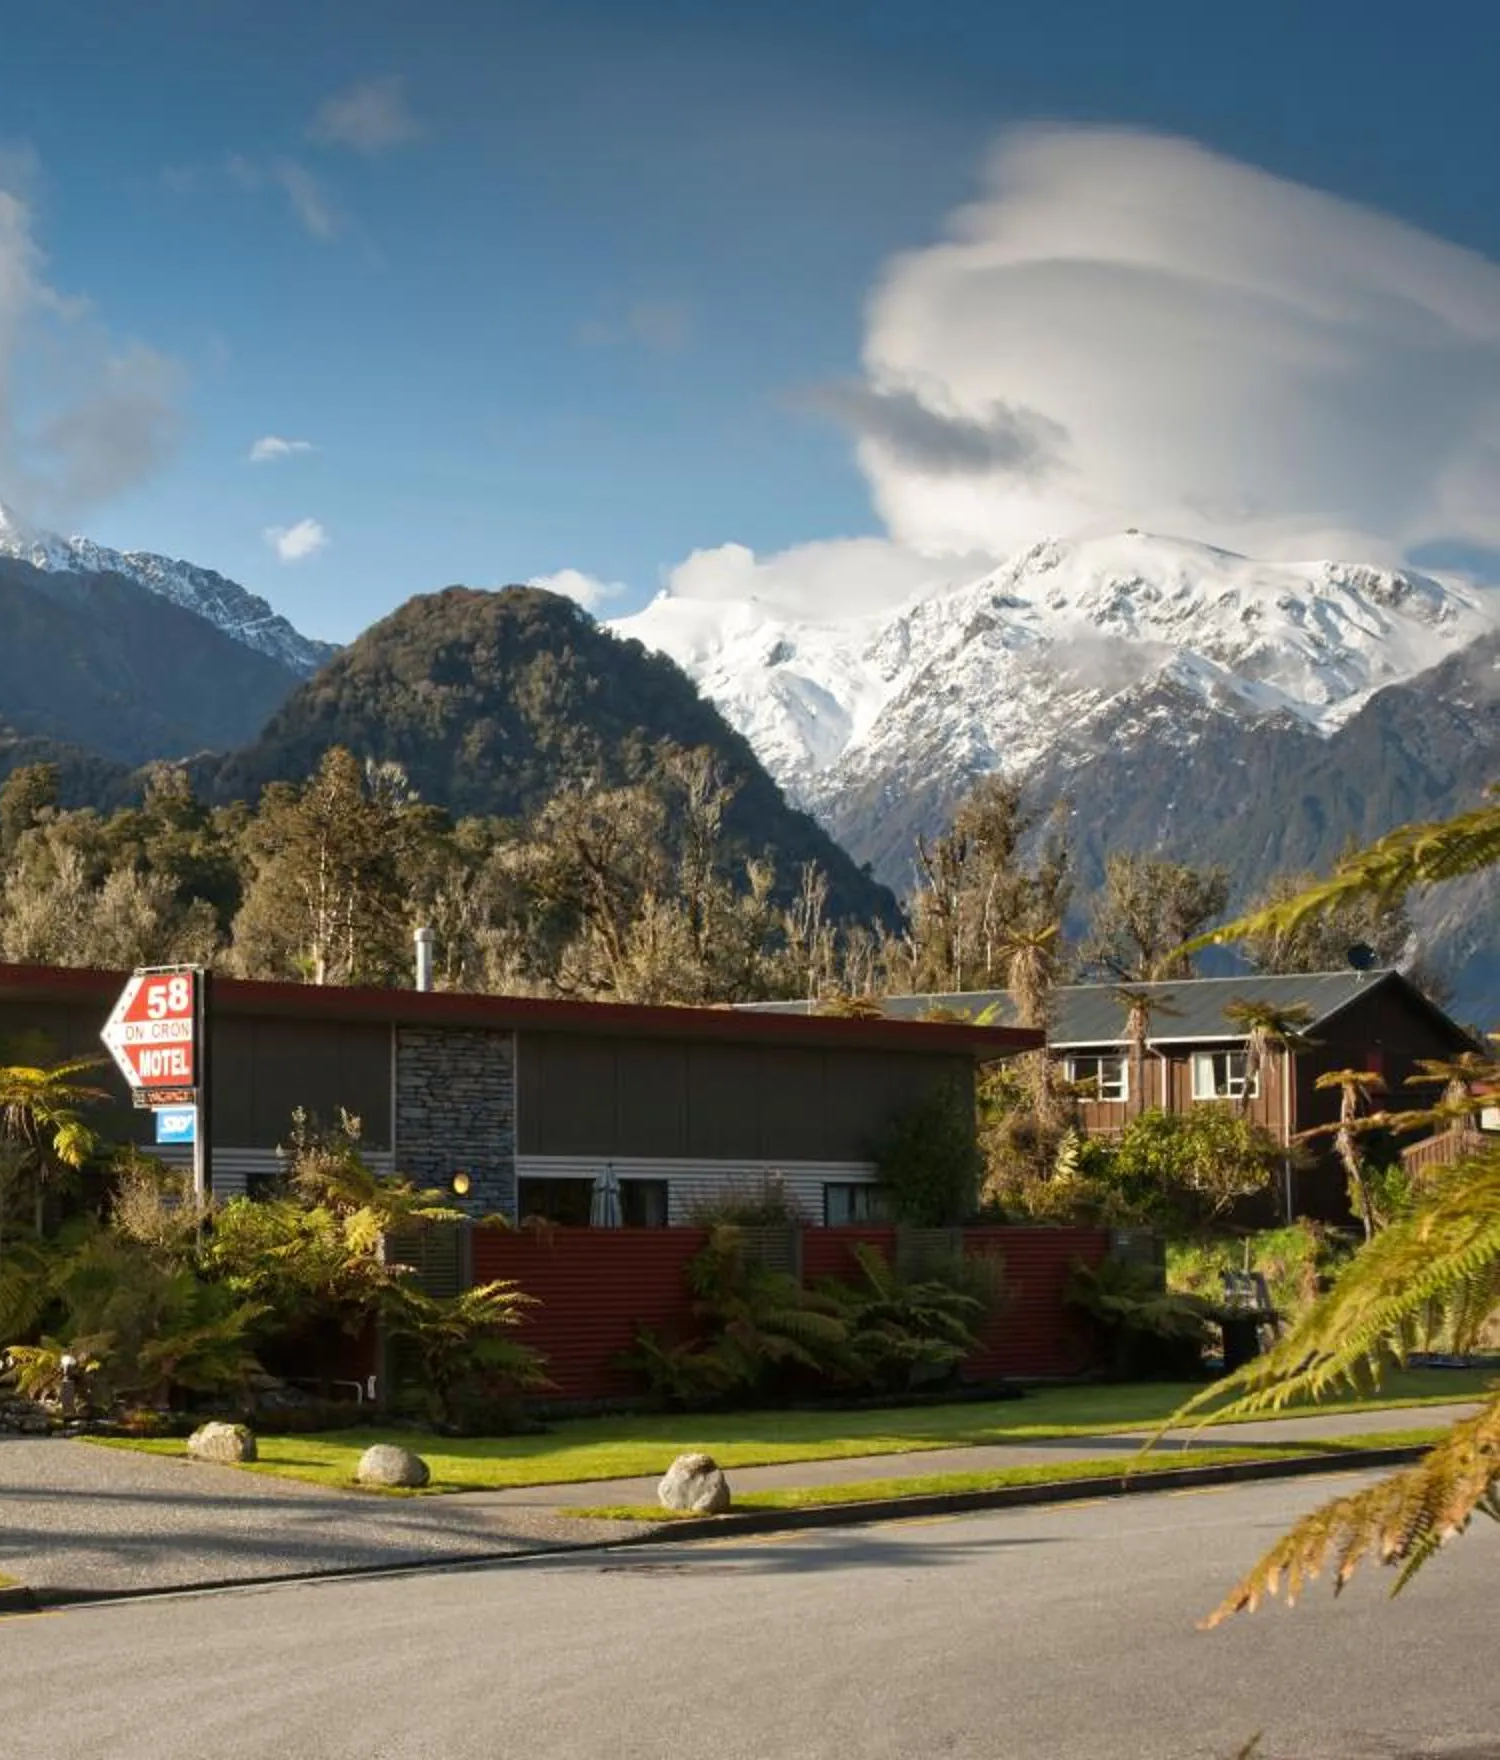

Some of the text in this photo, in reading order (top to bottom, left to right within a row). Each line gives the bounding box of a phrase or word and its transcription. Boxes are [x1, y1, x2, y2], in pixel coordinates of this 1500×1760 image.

[147, 977, 189, 1019] 58
[125, 1023, 190, 1041] ON CRON
[139, 1048, 190, 1077] MOTEL
